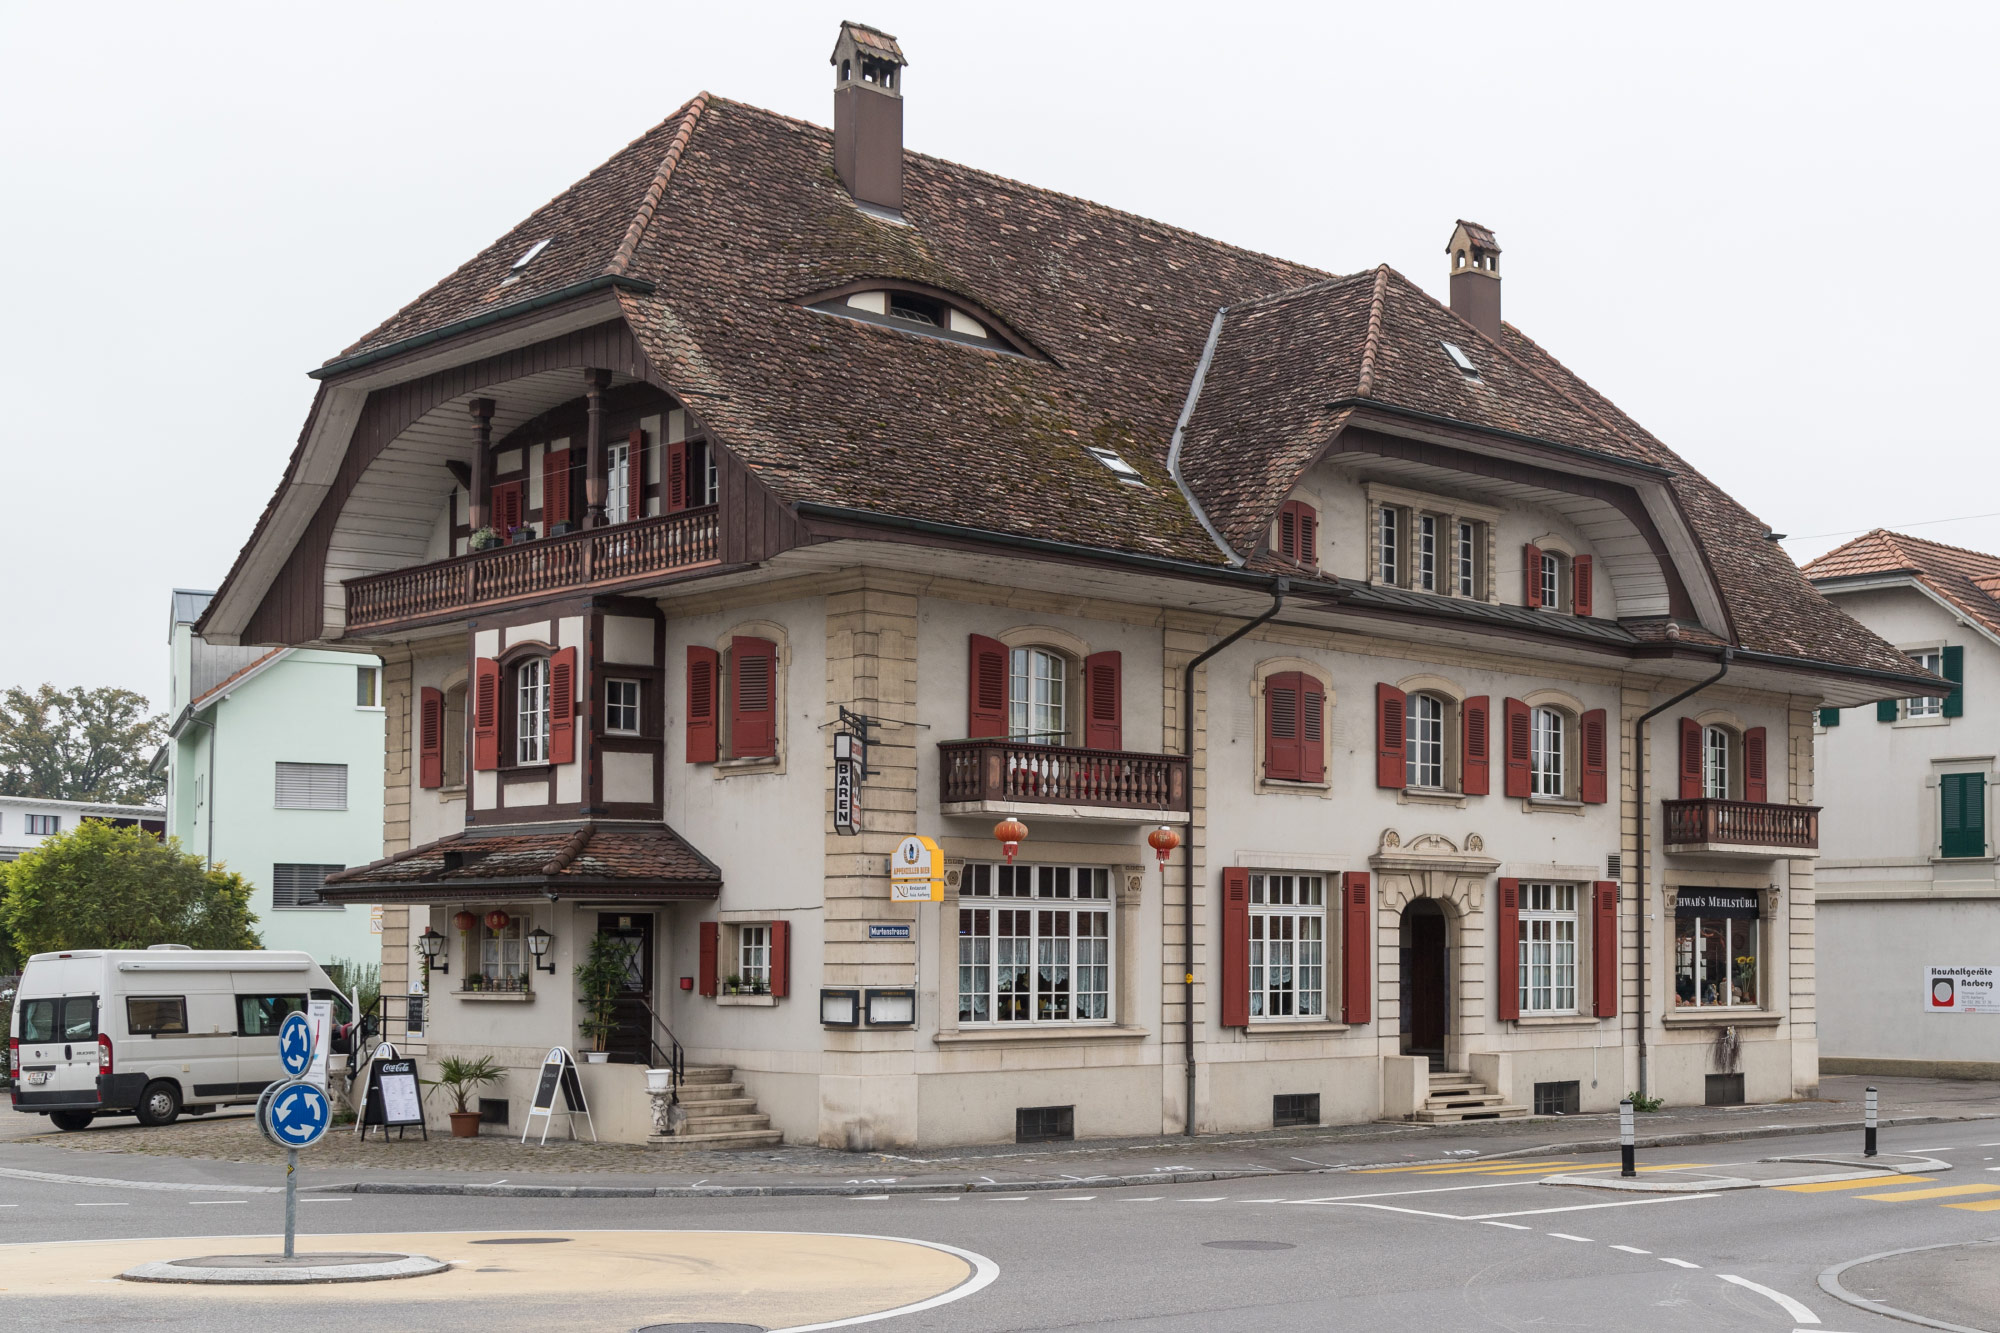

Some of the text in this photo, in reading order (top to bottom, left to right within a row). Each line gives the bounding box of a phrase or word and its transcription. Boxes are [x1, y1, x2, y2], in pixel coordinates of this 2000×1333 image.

[839, 764, 849, 822] BÄREN
[1676, 896, 1757, 908] CHWAB'S MEHLSTÜBLI
[871, 927, 909, 936] Murtenstrasse
[1931, 967, 1993, 977] Haushaltgeräte
[1961, 979, 1993, 989] Aarberg
[382, 1062, 410, 1073] Coca-Cola
